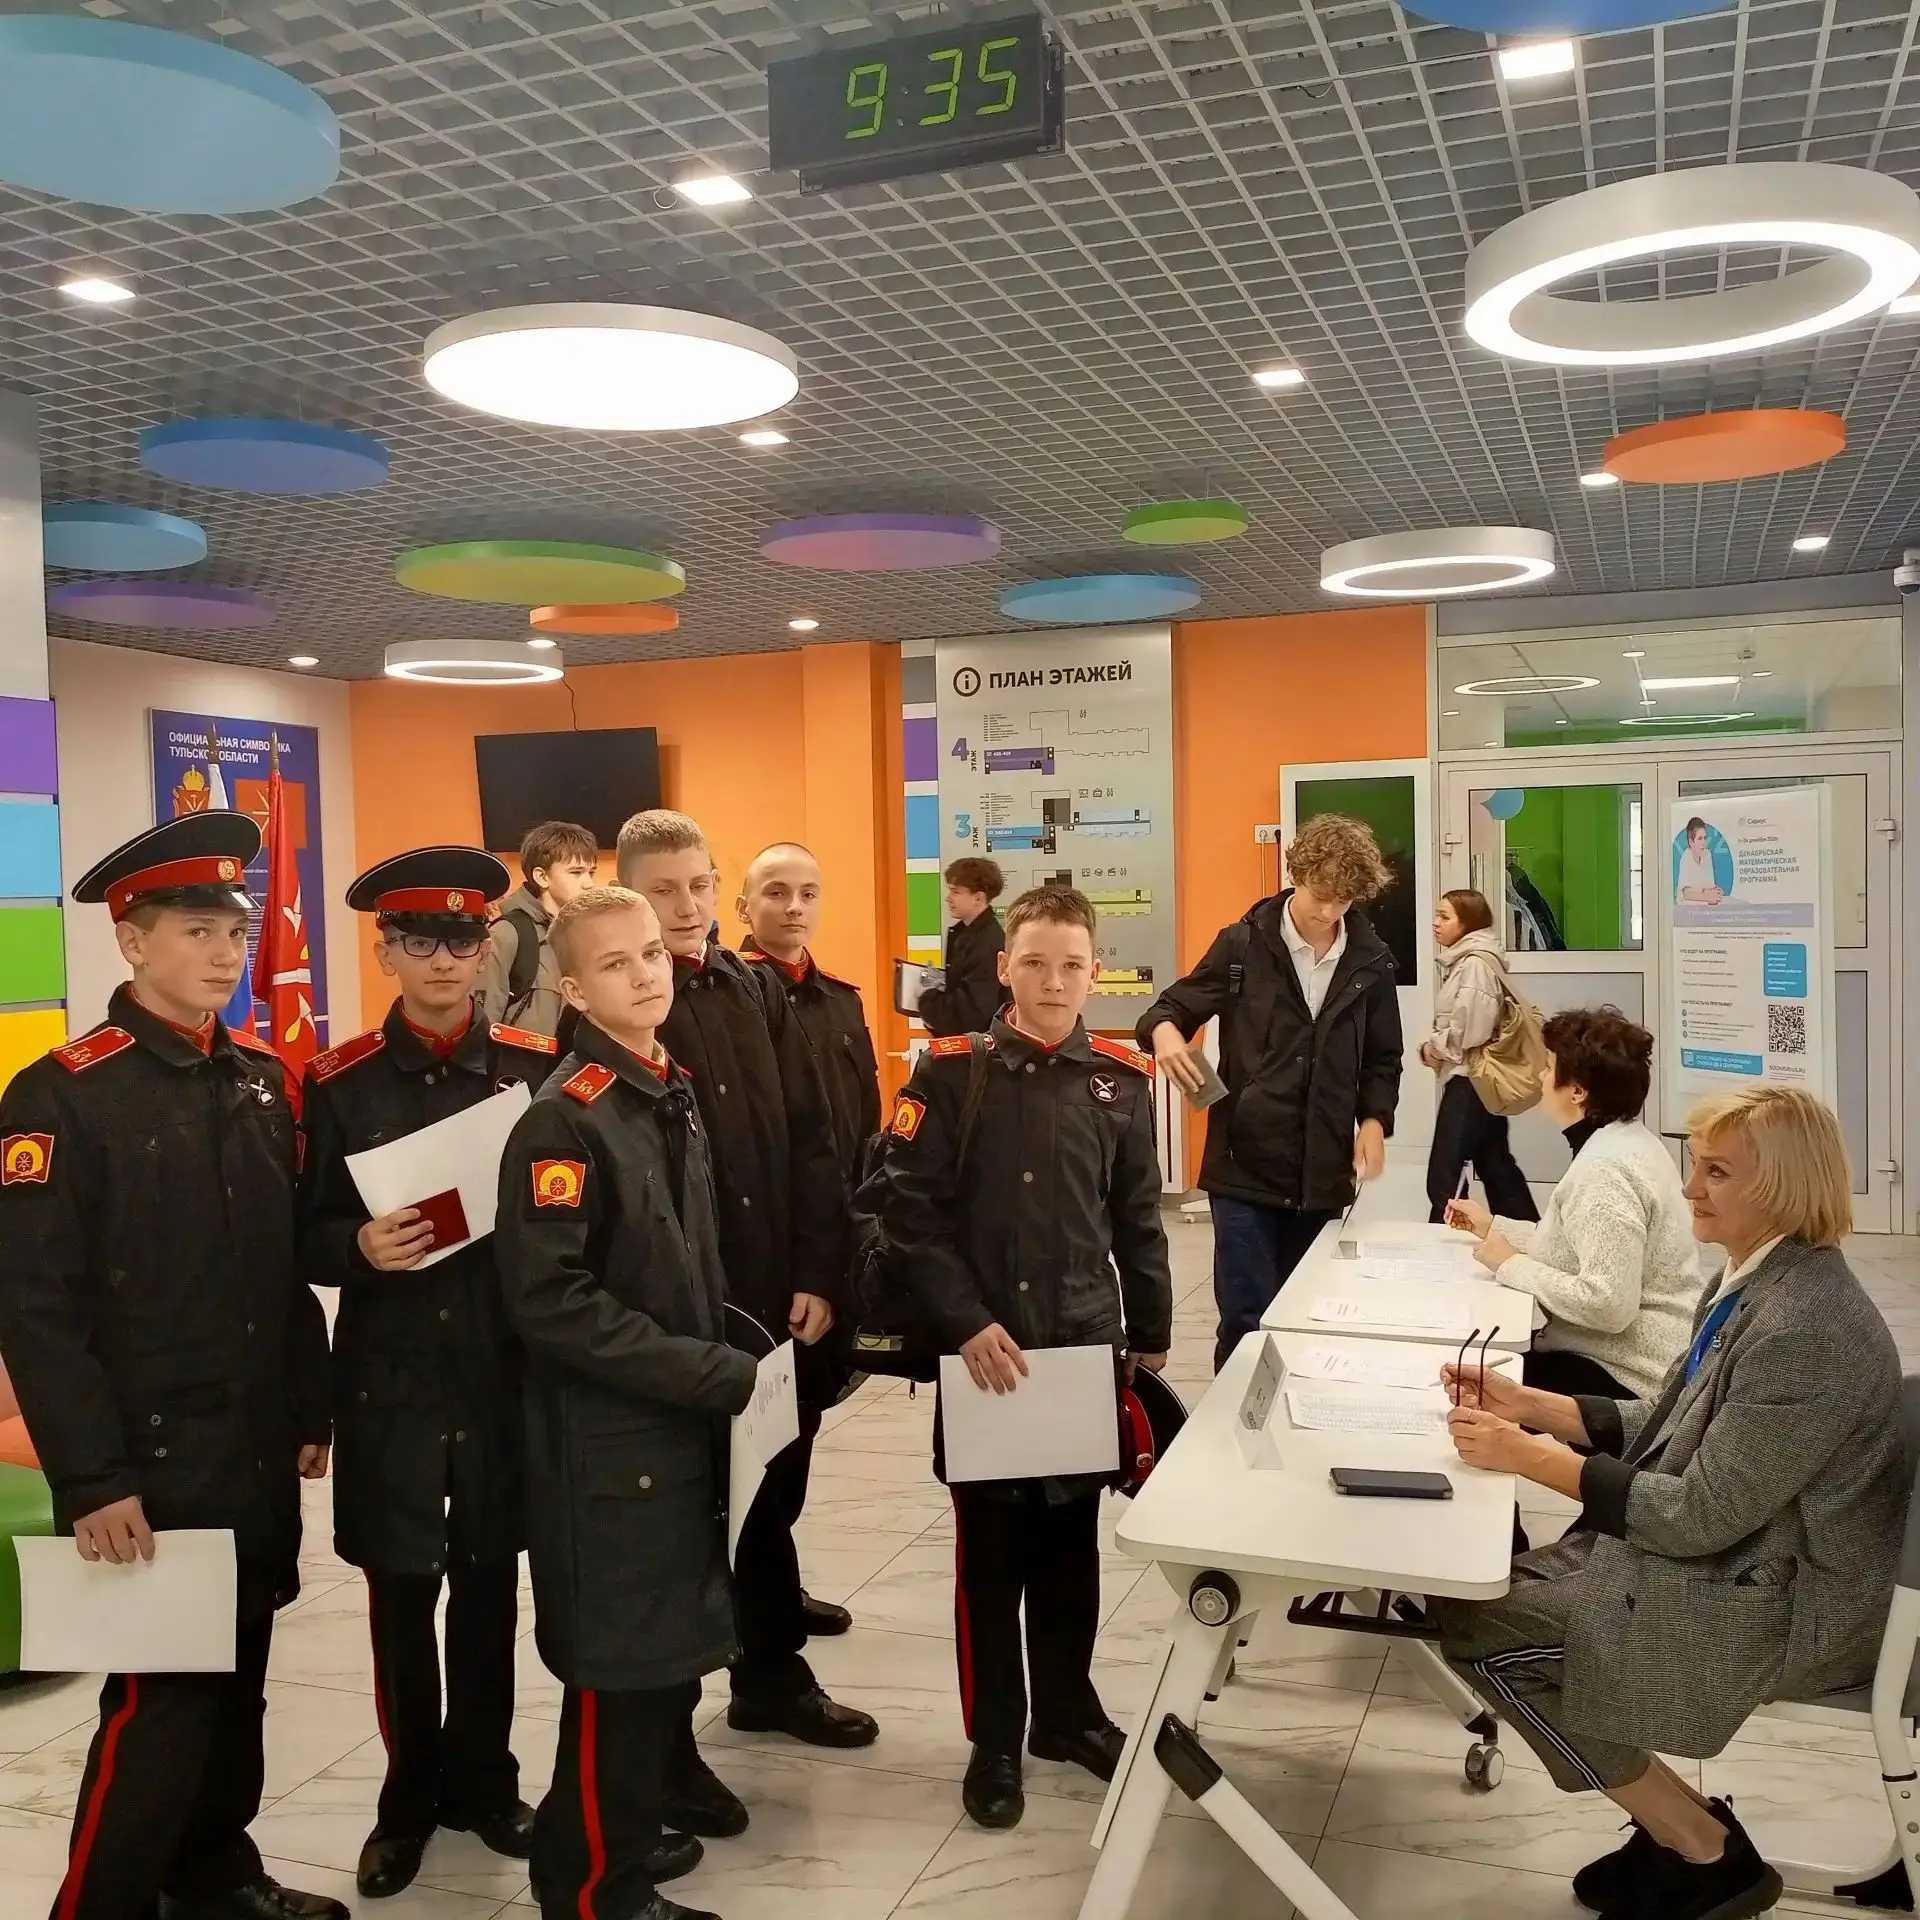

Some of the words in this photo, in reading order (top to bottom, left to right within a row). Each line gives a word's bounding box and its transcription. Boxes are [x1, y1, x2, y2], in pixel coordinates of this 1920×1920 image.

[989, 669, 1043, 689] ПЛАН
[1049, 660, 1132, 685] ЭТАЖЕЙ
[169, 731, 239, 749] ОФИЦИАЬНАЯ
[218, 750, 259, 764] ОБЛАСТИ
[951, 737, 970, 762] 4
[970, 750, 978, 772] ЭТАЖ
[954, 814, 971, 839] 3
[1738, 848, 1784, 858] ДЕКАБРЬСКАЯ
[1738, 857, 1797, 866] МАТЕМАТИЧЕСКАЯ
[1739, 866, 1800, 875] ОБРАЗОВАТЕЛЬНАЯ
[1739, 875, 1778, 884] ПРОГРАММА
